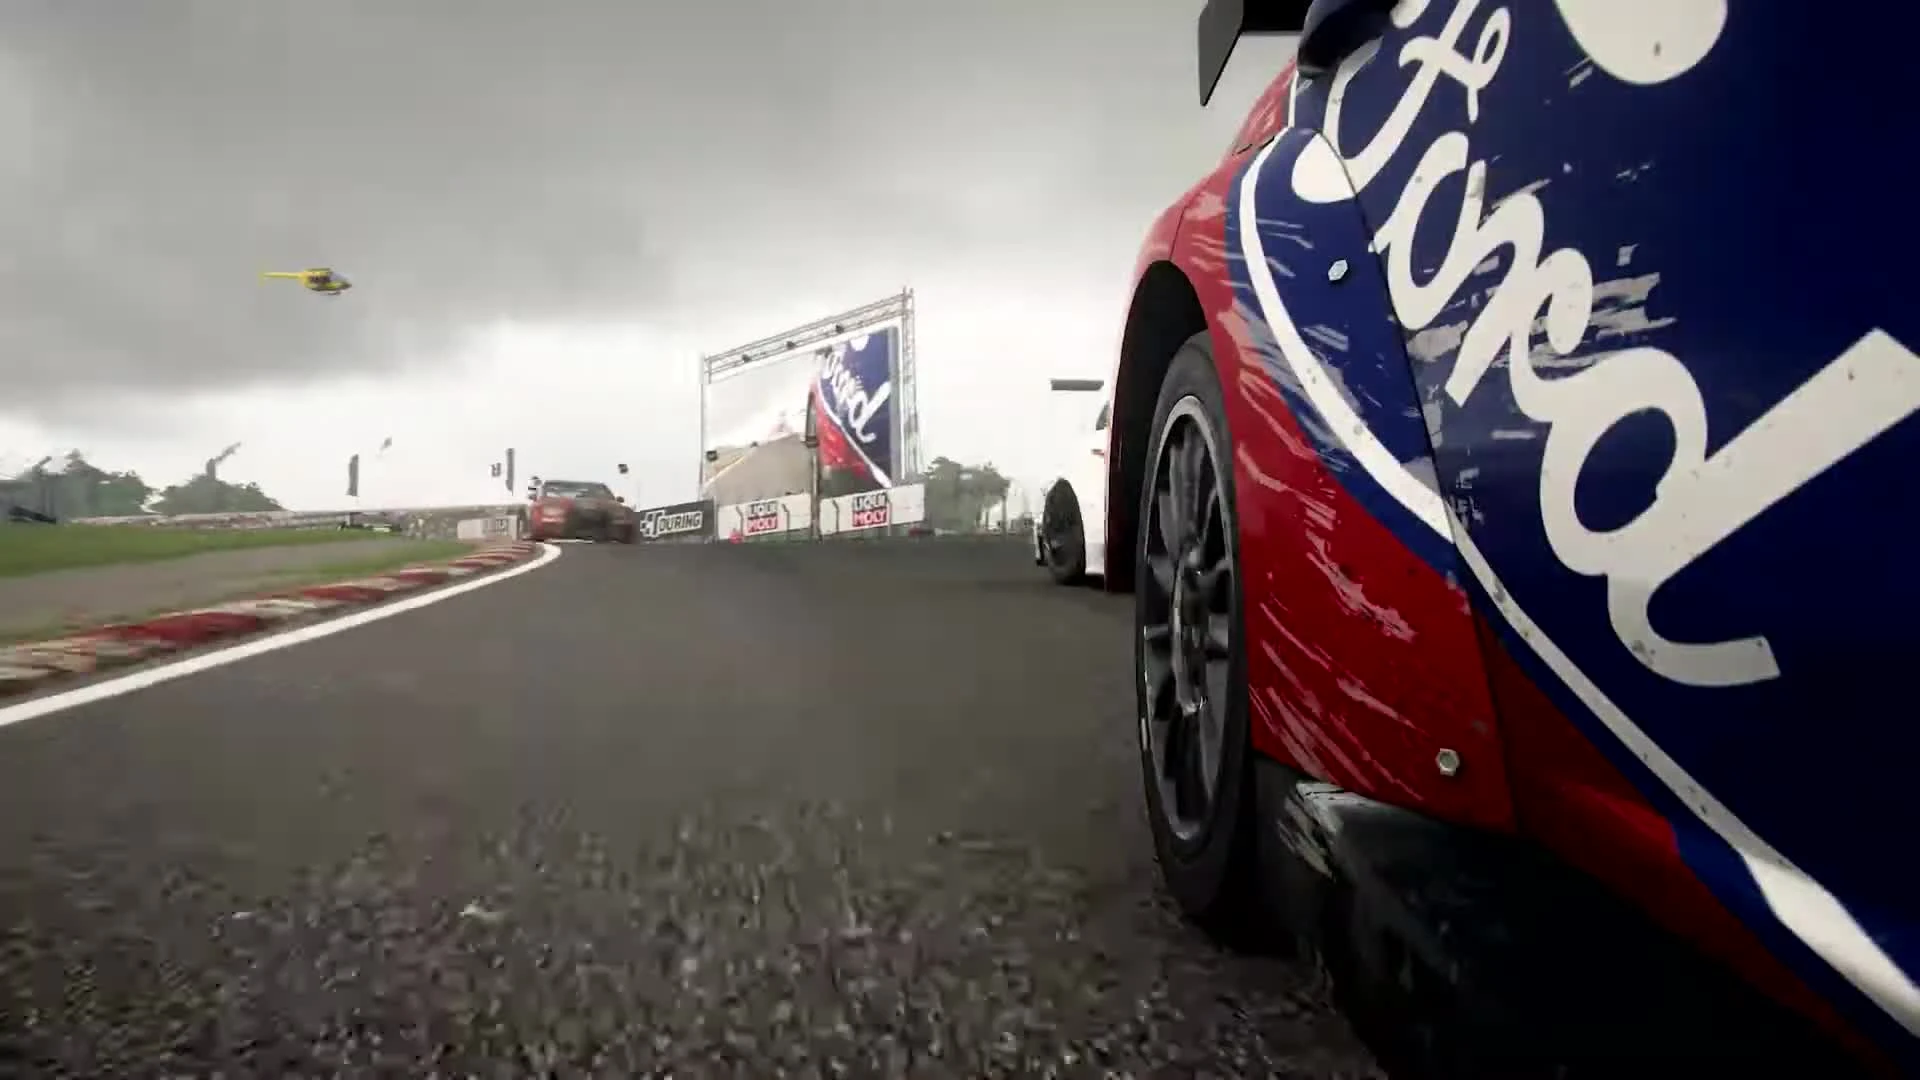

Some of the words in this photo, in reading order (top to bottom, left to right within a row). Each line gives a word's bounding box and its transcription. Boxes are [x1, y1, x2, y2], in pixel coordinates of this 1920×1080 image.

[1292, 0, 1920, 688] Ford
[645, 510, 703, 538] TOURING
[748, 516, 777, 533] MOLY
[852, 508, 887, 527] MOLY
